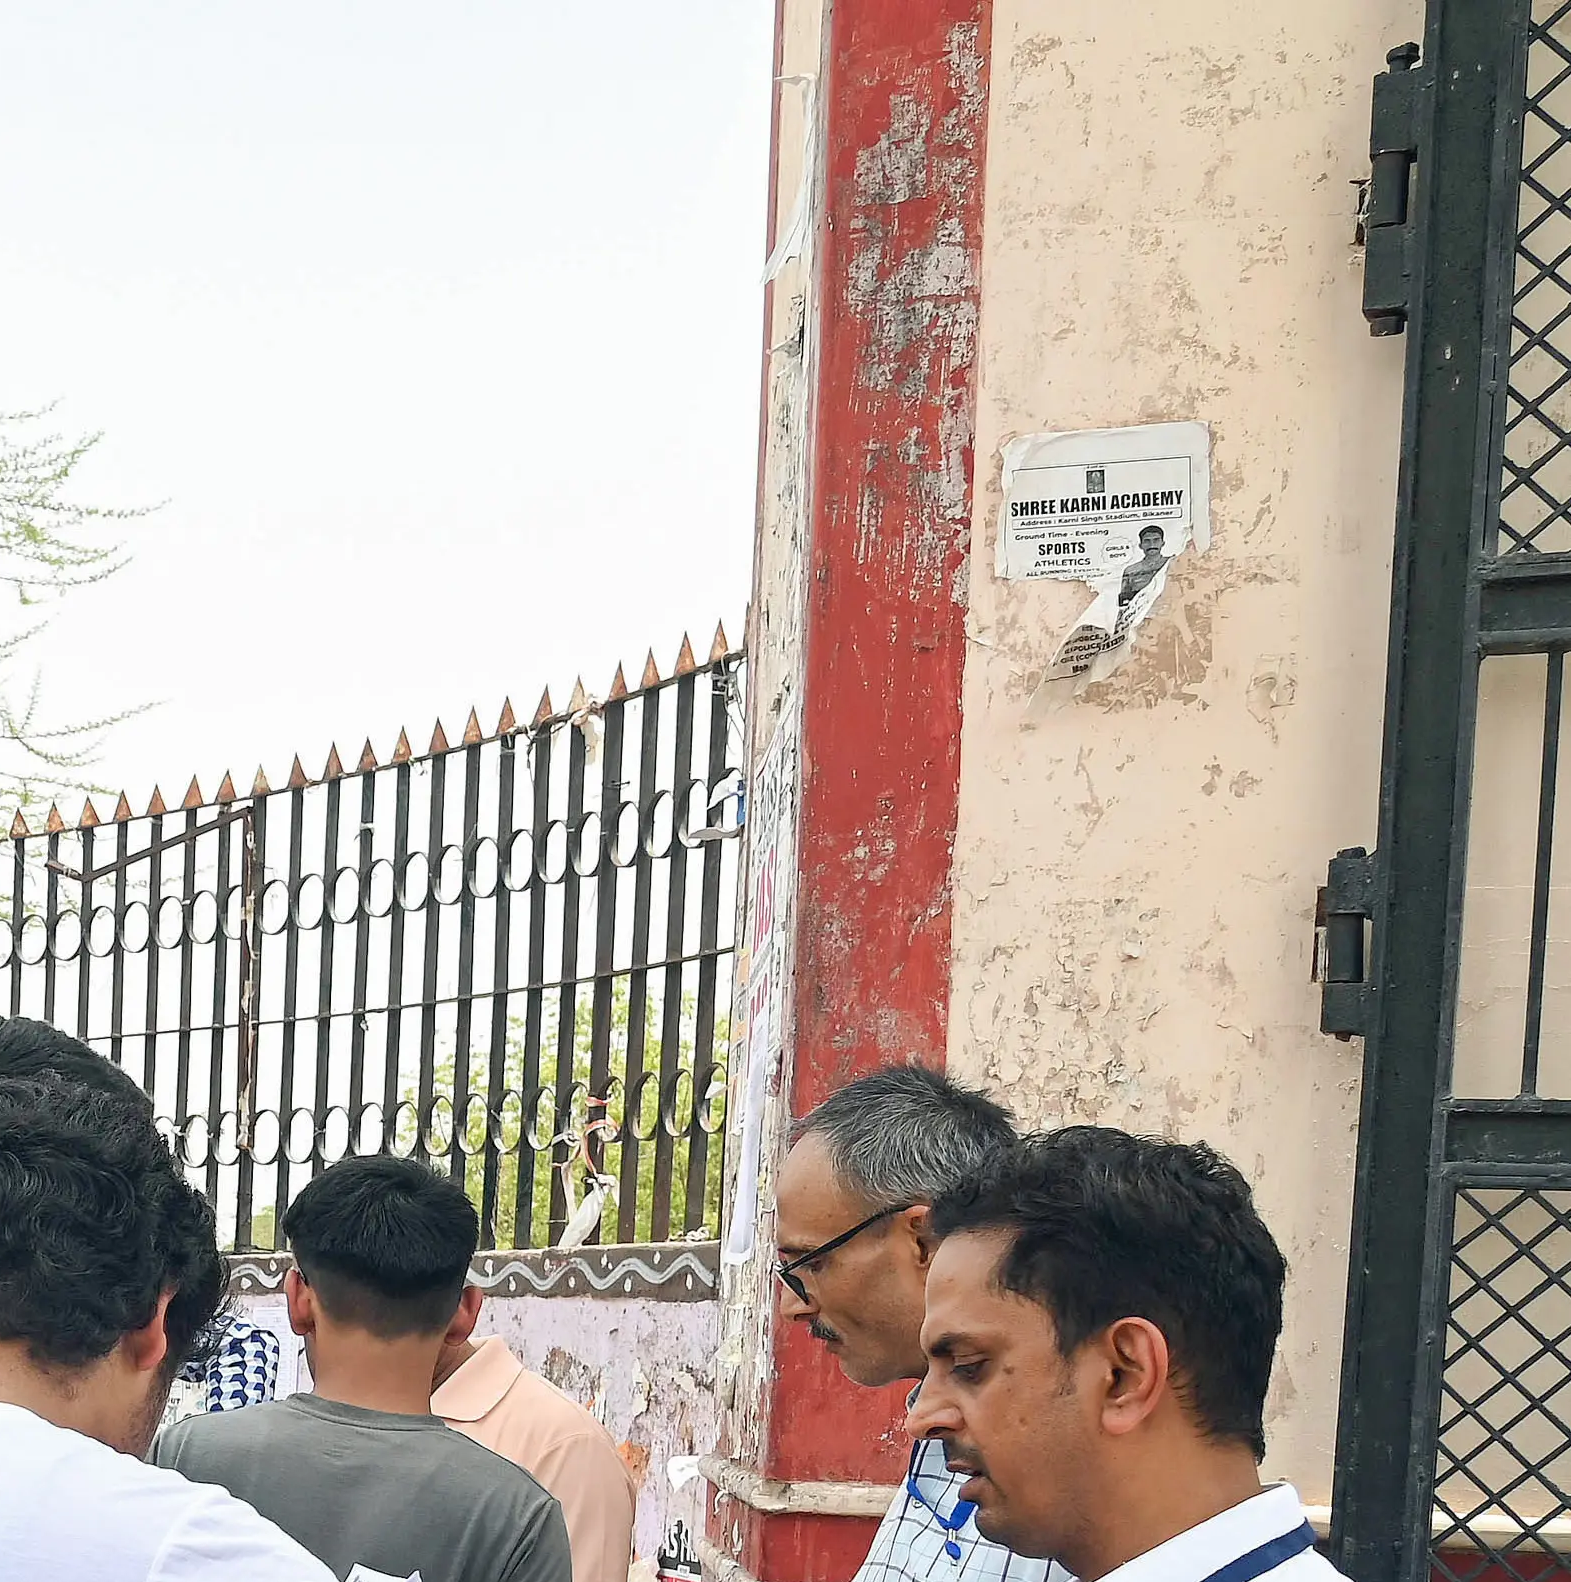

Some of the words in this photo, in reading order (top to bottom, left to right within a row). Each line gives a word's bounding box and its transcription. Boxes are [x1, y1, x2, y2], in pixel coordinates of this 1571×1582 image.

[1011, 500, 1056, 517] SHREE
[1060, 496, 1106, 513] KARNI
[1110, 490, 1183, 509] ACADEMY
[1020, 519, 1052, 527] Address
[1058, 516, 1079, 524] Karni
[1081, 516, 1104, 524] Singh
[1015, 532, 1045, 541] Ground
[1048, 531, 1068, 539] Time
[1076, 528, 1109, 538] Evening
[1038, 541, 1085, 556] SPORTS
[1034, 558, 1091, 568] ATHLETICS
